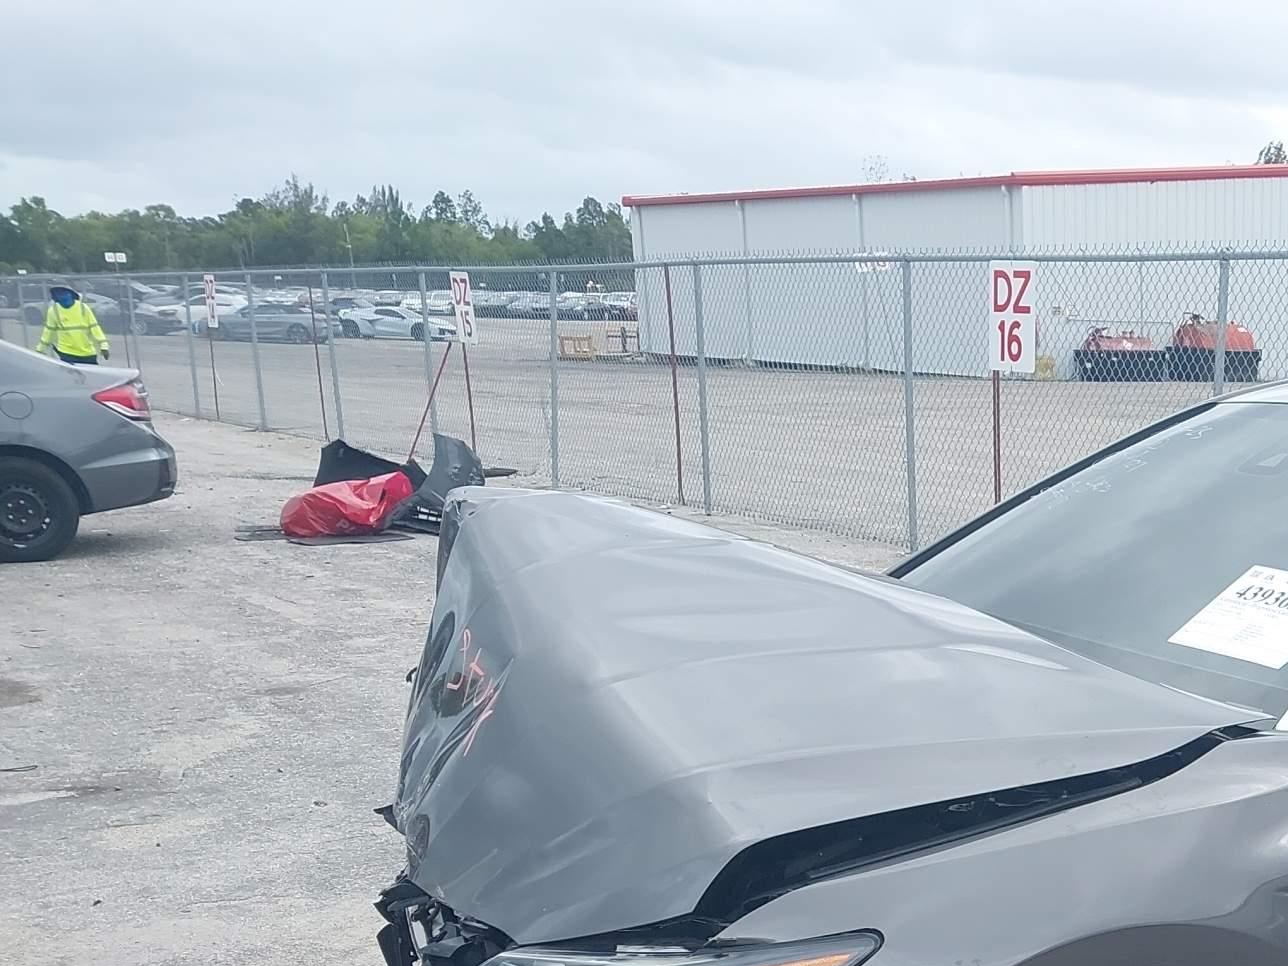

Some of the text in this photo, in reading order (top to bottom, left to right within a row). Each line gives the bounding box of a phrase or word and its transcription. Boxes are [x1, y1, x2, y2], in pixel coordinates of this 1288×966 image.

[452, 277, 471, 307] DZ
[993, 269, 1031, 314] DZ
[460, 310, 473, 338] 15
[998, 319, 1022, 362] 16
